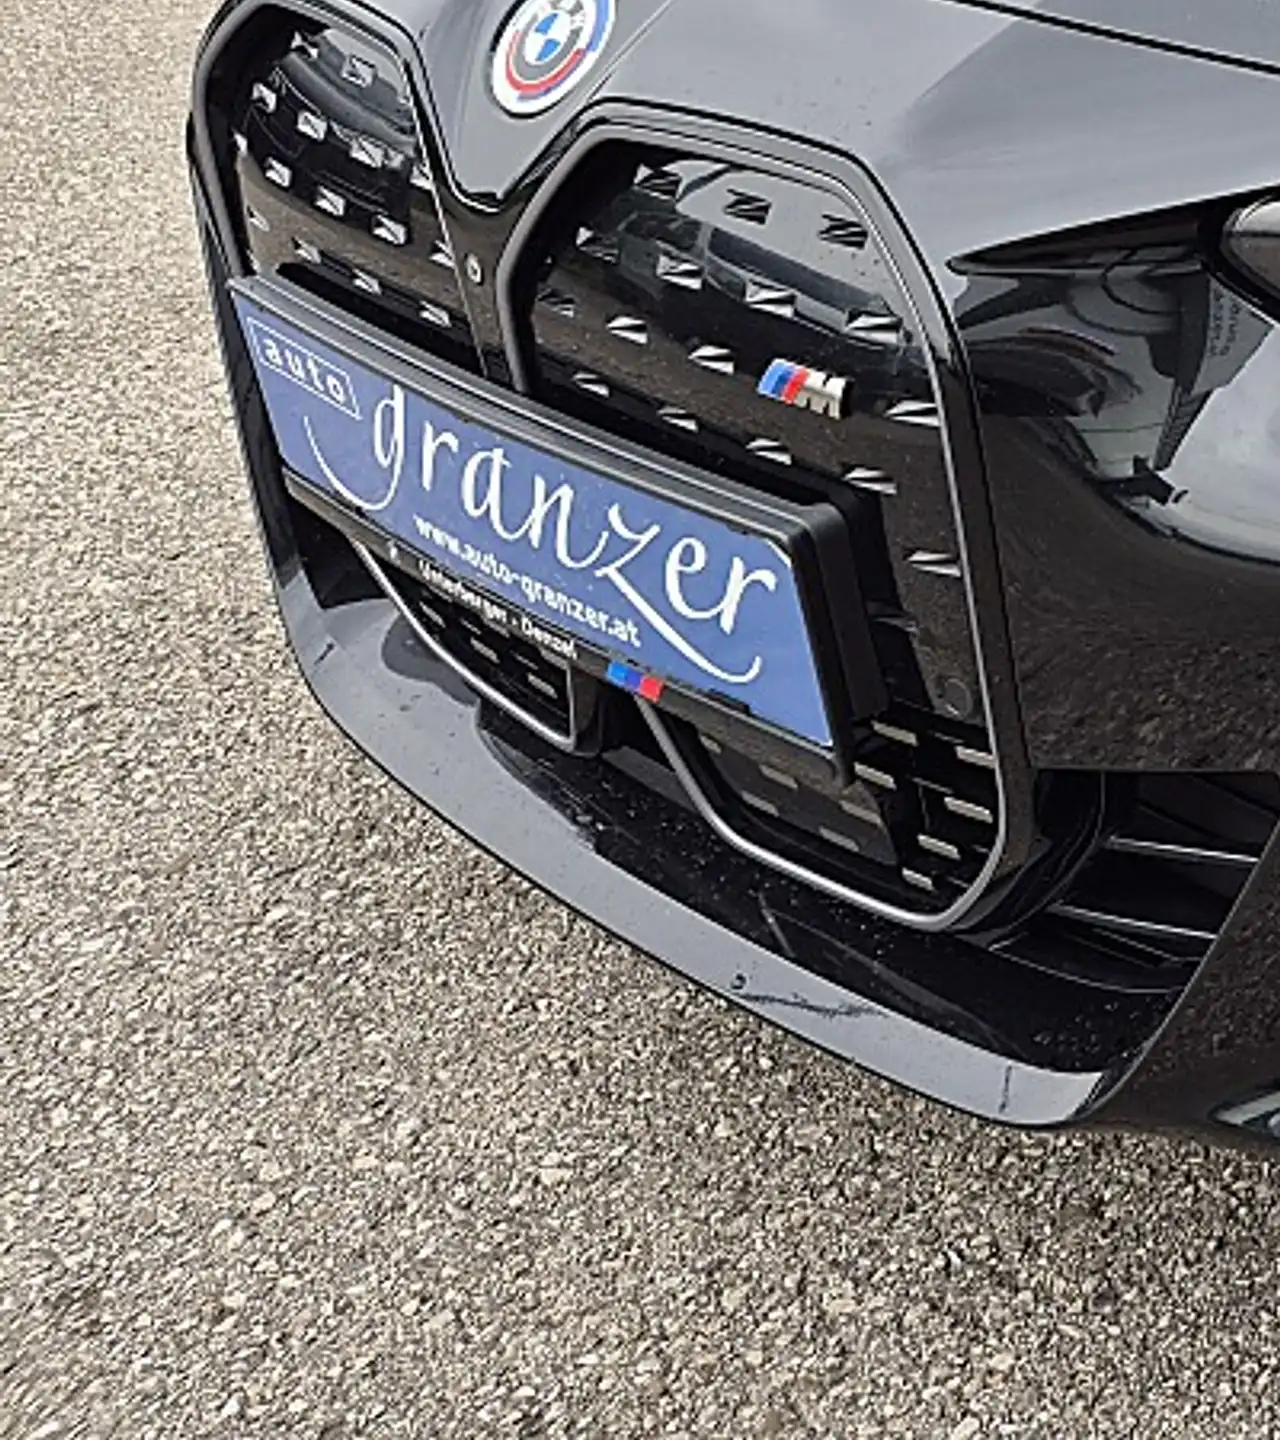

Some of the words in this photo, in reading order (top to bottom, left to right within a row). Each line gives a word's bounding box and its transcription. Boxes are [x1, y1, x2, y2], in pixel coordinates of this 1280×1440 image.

[264, 338, 345, 405] auto
[304, 384, 777, 685] granzer
[412, 513, 642, 648] www.auto-granzer.at
